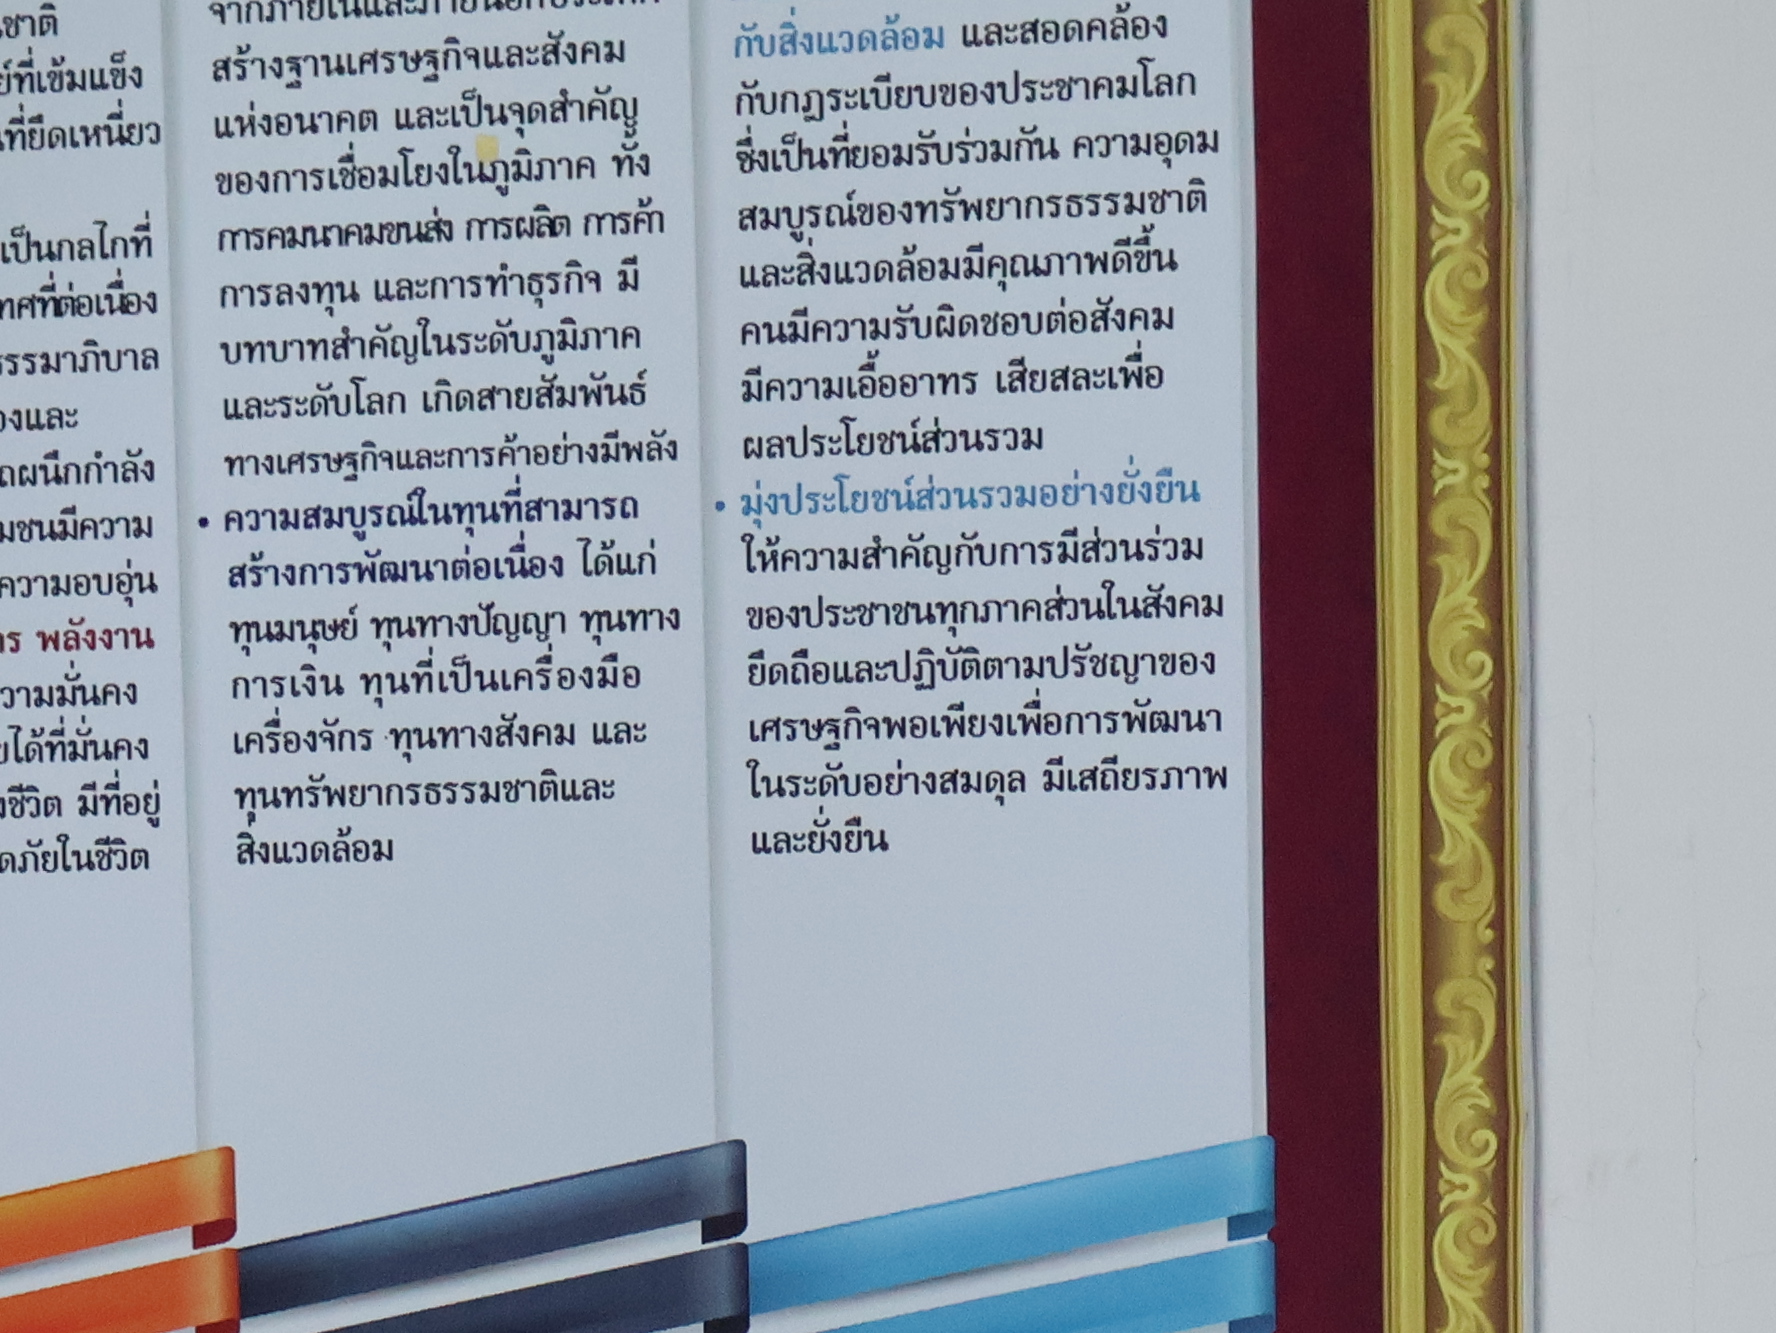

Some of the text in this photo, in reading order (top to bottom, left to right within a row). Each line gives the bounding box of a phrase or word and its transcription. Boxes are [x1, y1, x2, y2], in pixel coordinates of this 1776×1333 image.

[735, 1, 1168, 58] กับสิ่งแวดล้อม และสอดคล้อง
[212, 30, 625, 89] สร้างฐานเศรษฐกิจและสังคม
[214, 85, 638, 139] แห่งอนาคต และเป็นจุดสำคัญ
[736, 56, 1196, 123] กับกฎระเบียบของประชาคมโลก
[215, 141, 650, 197] ของการเชื่อมโยงในภูมิภาค ทั้ง
[736, 120, 1218, 174] ซึ่งเป็นที่ยอมรับร่วมกัน ความอุดม
[218, 196, 664, 252] การคมนาคมขนส่ง การผลิต การค้า
[738, 177, 1207, 243] สมบูรณ์ของทรัพยากรธรรมชาติ
[220, 254, 639, 318] การลงทุน และการทำธุรกิจ มี
[740, 223, 1179, 293] และสิ่งแวดล้อมมีคุณภาพดีขึ้น
[219, 316, 641, 366] บทบาทสำคัญในระดับภูมิภาค
[741, 295, 1174, 350] คนมีความรับผิดชอบต่อสังคม
[223, 368, 647, 420] และระดับโลก เกิดสายสัมพันธ์
[741, 339, 1164, 403] มีความเอื้ออาทร เสียสละเพื่อ
[224, 429, 678, 485] ทางเศรษฐกิจและการค้าอย่างมีพลัง
[743, 415, 1043, 459] ผลประโยชน์ส่วนรวม
[224, 474, 639, 542] ความสมบูรณ์ในทุนที่สามารถ
[741, 455, 1200, 530] มุ่งประโยชน์ส่วนรวมอย่างยั่งยืน
[228, 531, 656, 588] สร้างการพัฒนาต่อเนื่อง ได้แก่
[740, 524, 1203, 575] ให้ความสำคัญกับการมีส่วนร่วม
[36, 616, 155, 652] พลังงาน
[228, 601, 680, 657] ทุนมนุษย์ ทุนทางปัญญา ทุนทาง
[746, 579, 1223, 638] ของประชาชนทุกภาคส่วนในสังคม
[232, 644, 641, 709] การเงิน ทุนที่เป็นเครื่องมือ
[748, 642, 1215, 691] ยึดถือและปฏิบัติตามปรัชญาของ
[234, 707, 647, 763] เครื่องจักร ทุนทางสังคม และ
[749, 687, 1221, 751] เศรษฐกิจพอเพียงเพื่อการพัฒนา
[77, 768, 160, 828] มีที่อยู่
[234, 768, 615, 820] ทุนทรัพยากรธรรมชาติและ
[745, 754, 1227, 806] ในระดับอย่างสมดุล มีเสถียรภาพ
[237, 811, 393, 865] สิ่งแวดล้อม
[752, 805, 889, 855] และยั่งยืน
